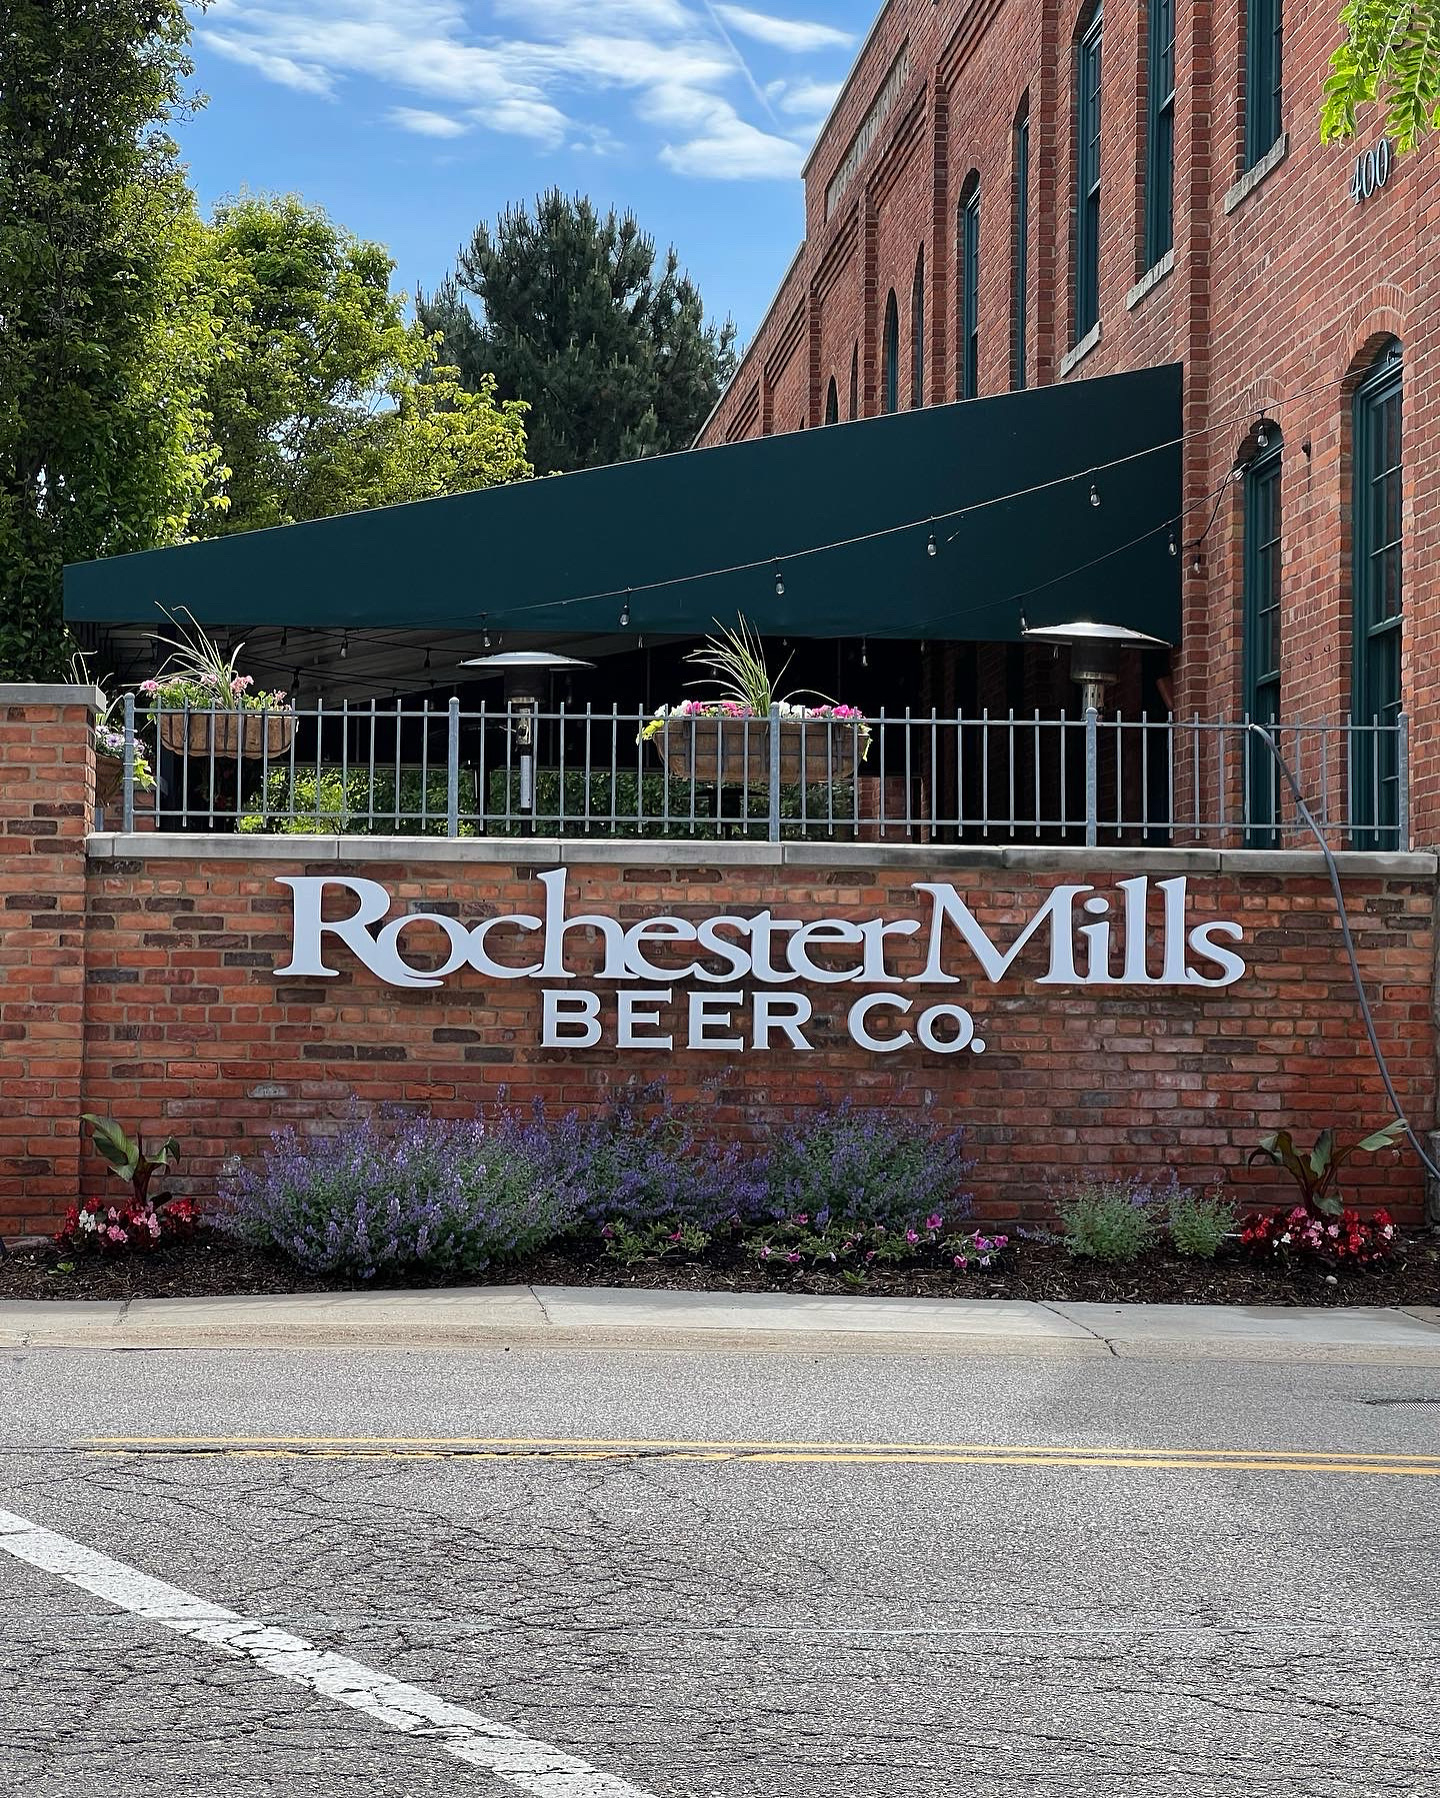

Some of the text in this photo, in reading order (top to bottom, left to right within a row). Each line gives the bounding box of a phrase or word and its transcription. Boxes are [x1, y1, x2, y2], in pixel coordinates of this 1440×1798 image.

[1350, 138, 1389, 204] 400
[540, 987, 986, 1054] BEER Co.
